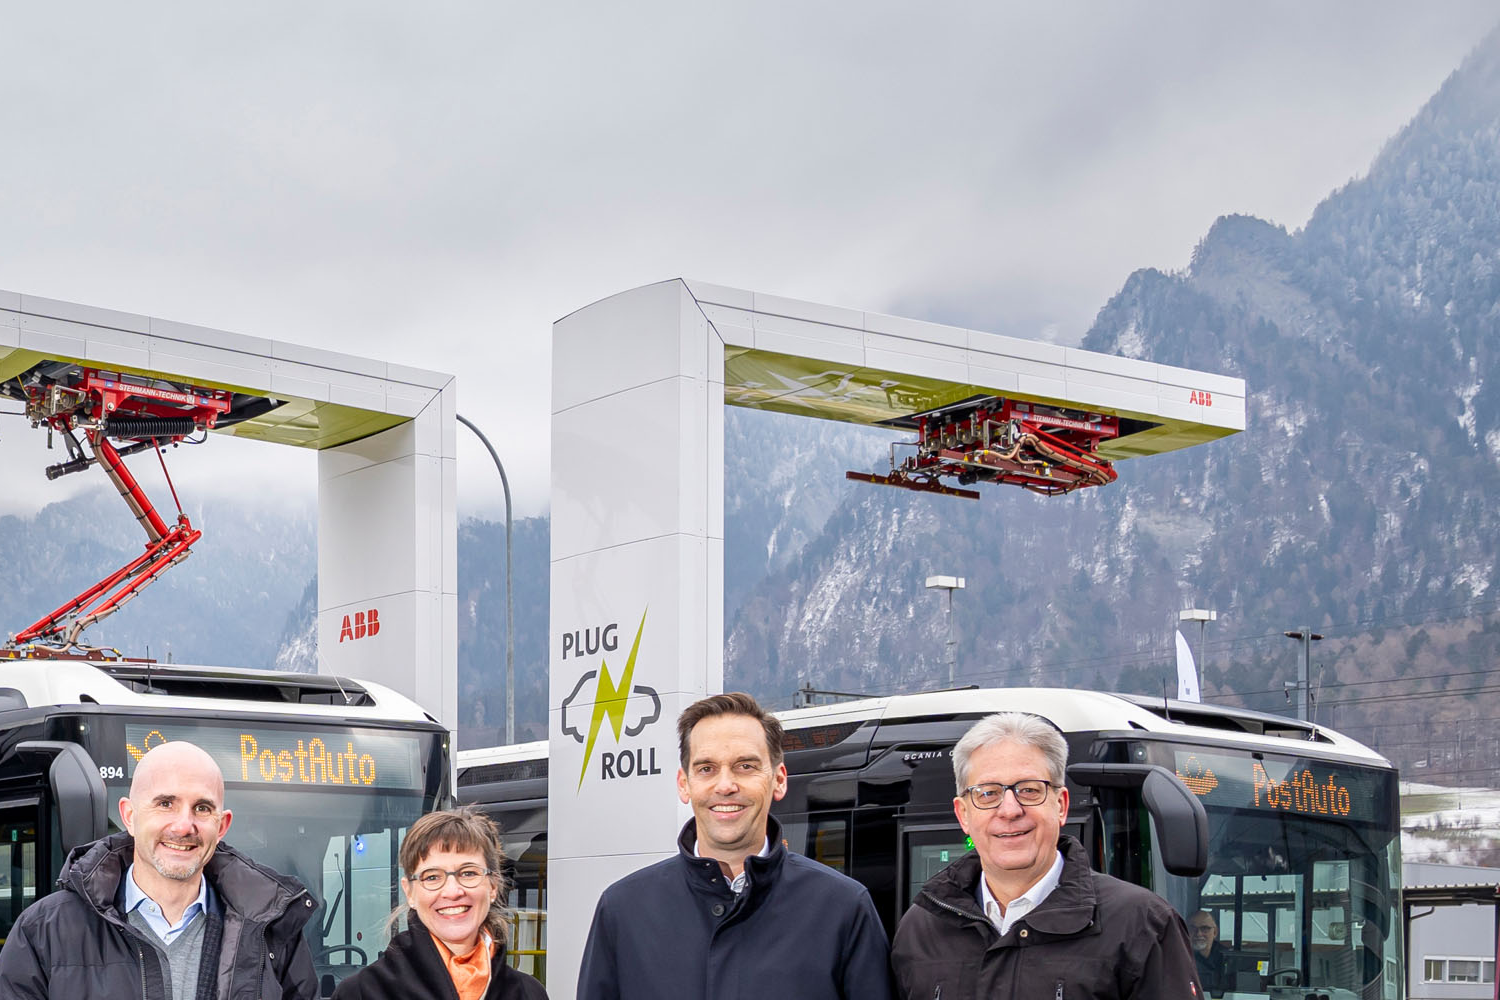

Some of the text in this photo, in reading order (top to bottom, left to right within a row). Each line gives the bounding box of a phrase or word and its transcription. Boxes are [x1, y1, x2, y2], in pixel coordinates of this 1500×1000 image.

[1189, 390, 1213, 407] ABB
[339, 608, 380, 643] ABB
[562, 623, 618, 660] PLUG
[99, 766, 124, 779] 894
[240, 734, 376, 785] PostAuto
[601, 747, 662, 780] ROLL
[904, 751, 943, 761] SCANIA
[1253, 763, 1351, 816] PostAuto
